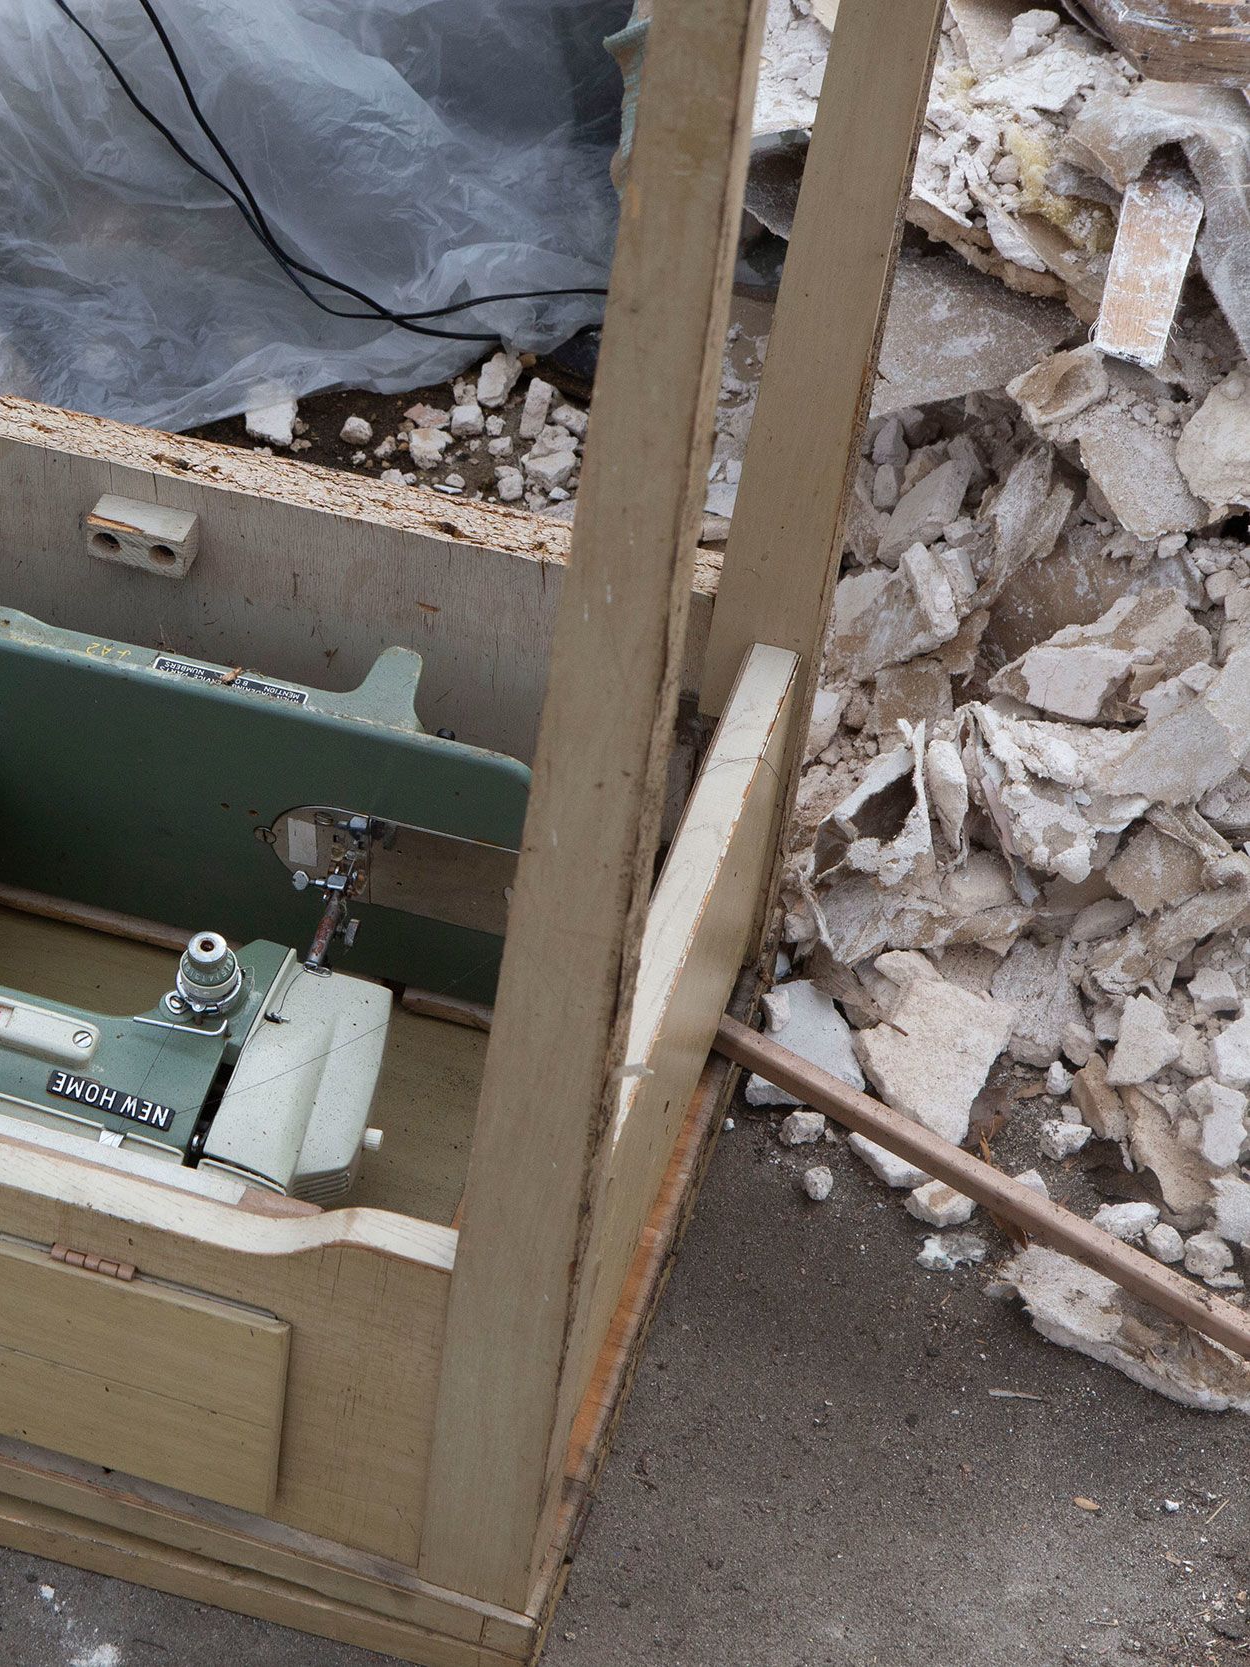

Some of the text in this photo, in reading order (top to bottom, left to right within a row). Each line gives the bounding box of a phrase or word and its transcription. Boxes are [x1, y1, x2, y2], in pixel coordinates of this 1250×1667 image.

[164, 661, 205, 676] NUMBERS
[263, 686, 300, 700] MENTION
[51, 1072, 170, 1127] NEW HOME
